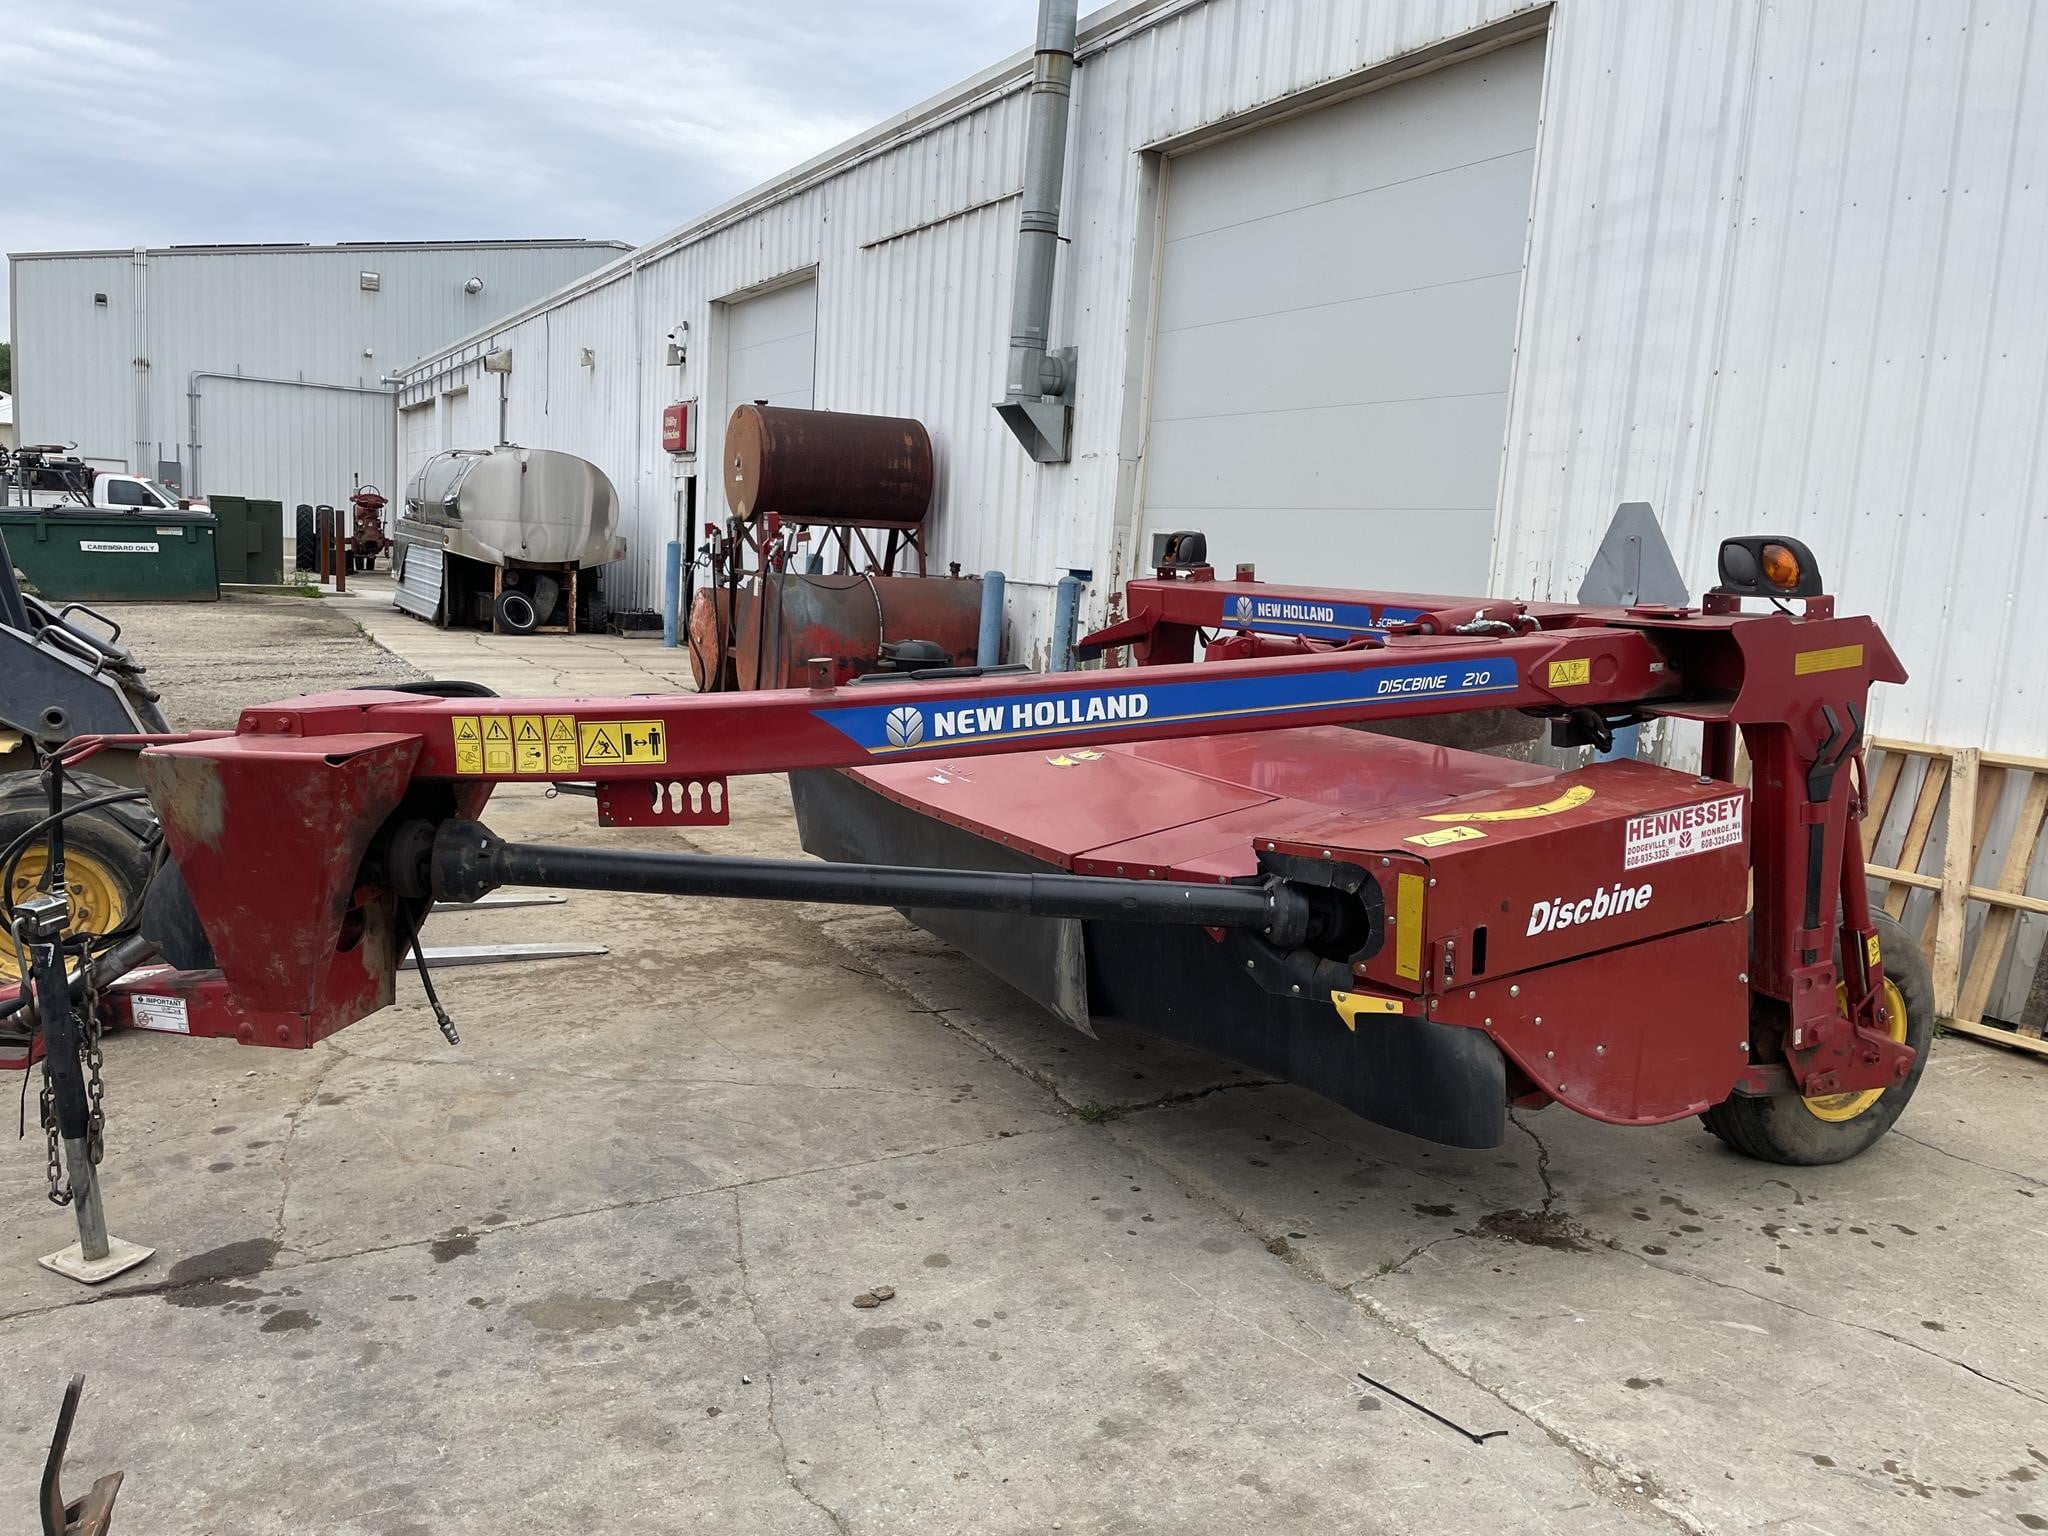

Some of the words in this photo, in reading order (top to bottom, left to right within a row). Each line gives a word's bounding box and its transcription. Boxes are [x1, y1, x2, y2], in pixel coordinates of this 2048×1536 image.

[1257, 602, 1281, 618] NEW
[1283, 604, 1334, 623] HOLLAND
[1377, 675, 1448, 696] DISCBINE
[1462, 671, 1491, 687] 210
[934, 705, 1005, 738] NEW
[1012, 693, 1149, 729] HOLLAND
[1628, 798, 1741, 843] HENNESSEY
[1668, 837, 1676, 847] WI
[1626, 848, 1670, 867] 608-935-3326
[1526, 883, 1654, 938] Discbine
[146, 998, 182, 1007] IMPORTANT
